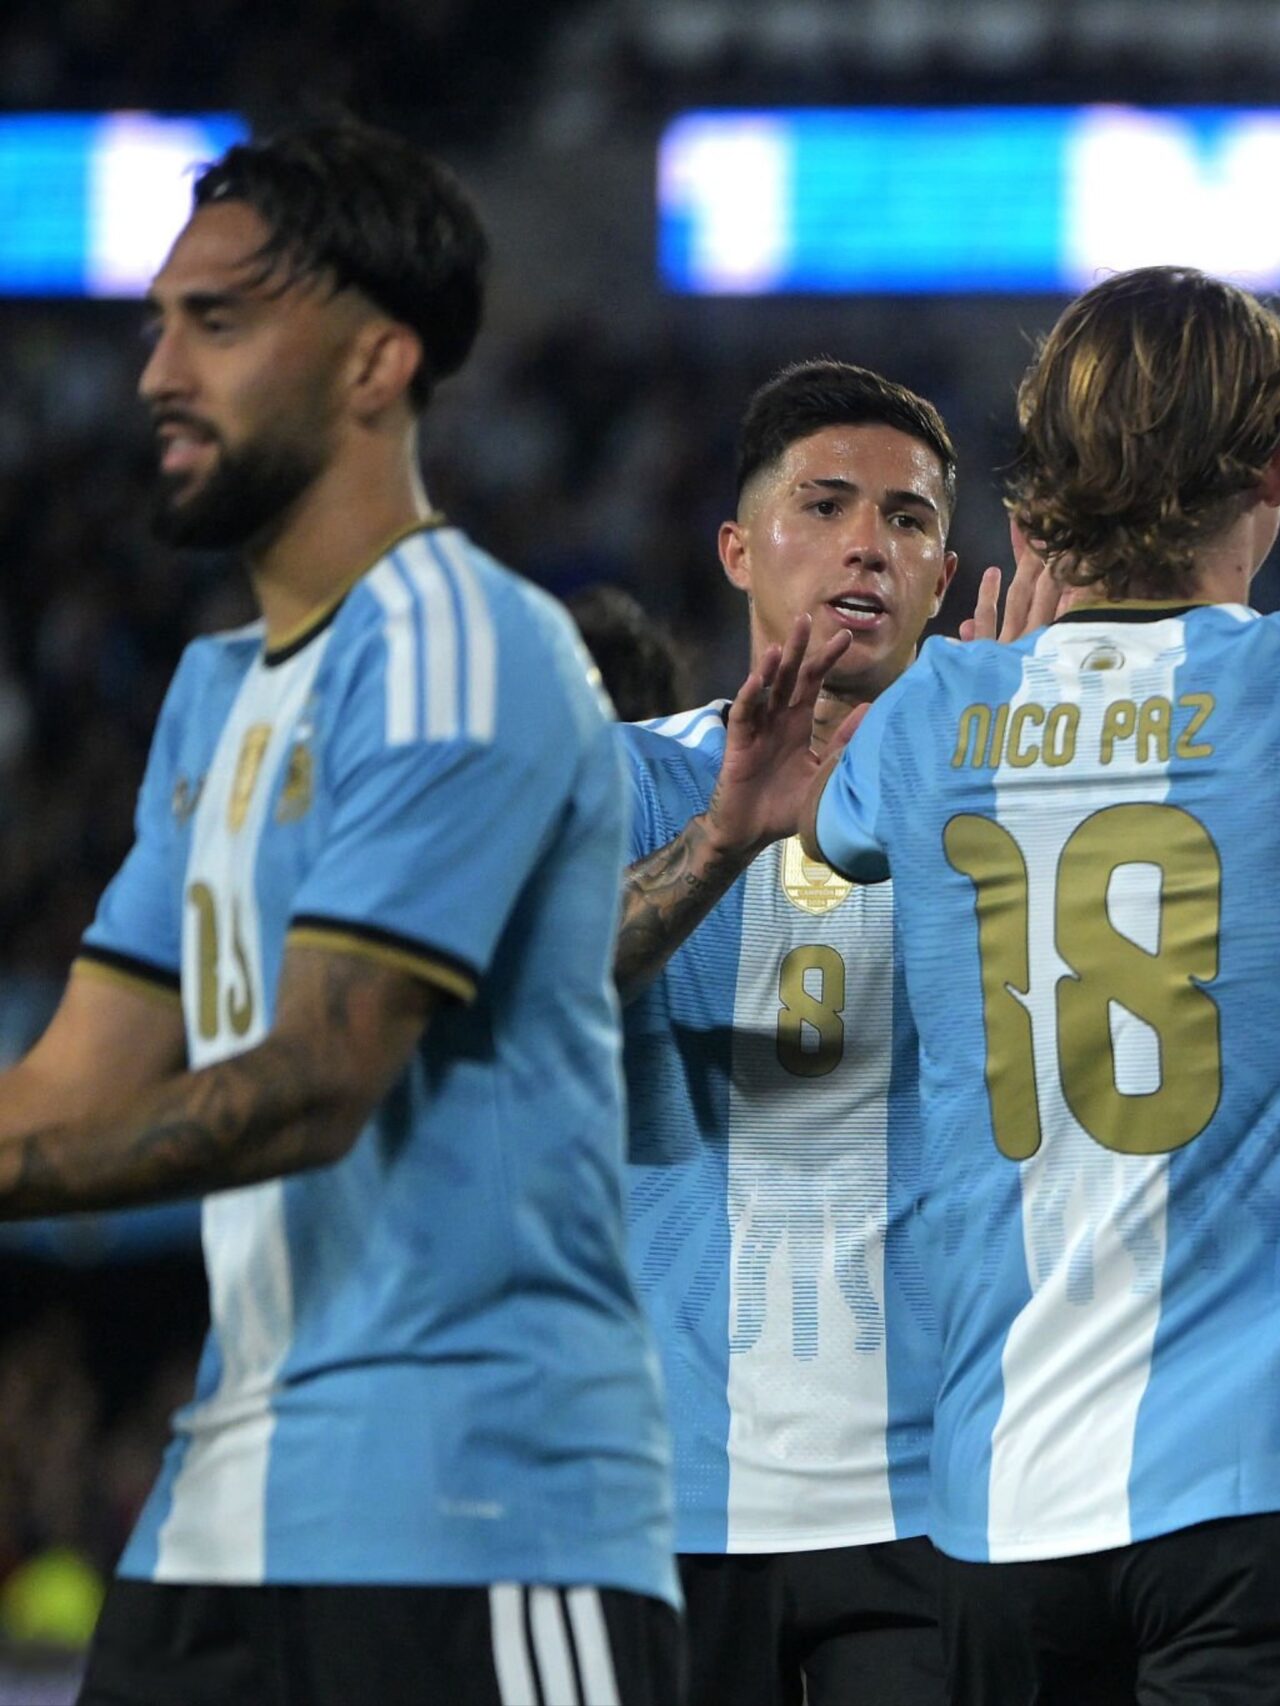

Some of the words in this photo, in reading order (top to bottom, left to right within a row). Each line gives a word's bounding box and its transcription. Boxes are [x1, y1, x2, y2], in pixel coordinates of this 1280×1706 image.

[951, 703, 1080, 768] NICO
[1099, 693, 1215, 764] PAZ
[777, 944, 845, 1078] 8
[942, 801, 1223, 1161] 18
